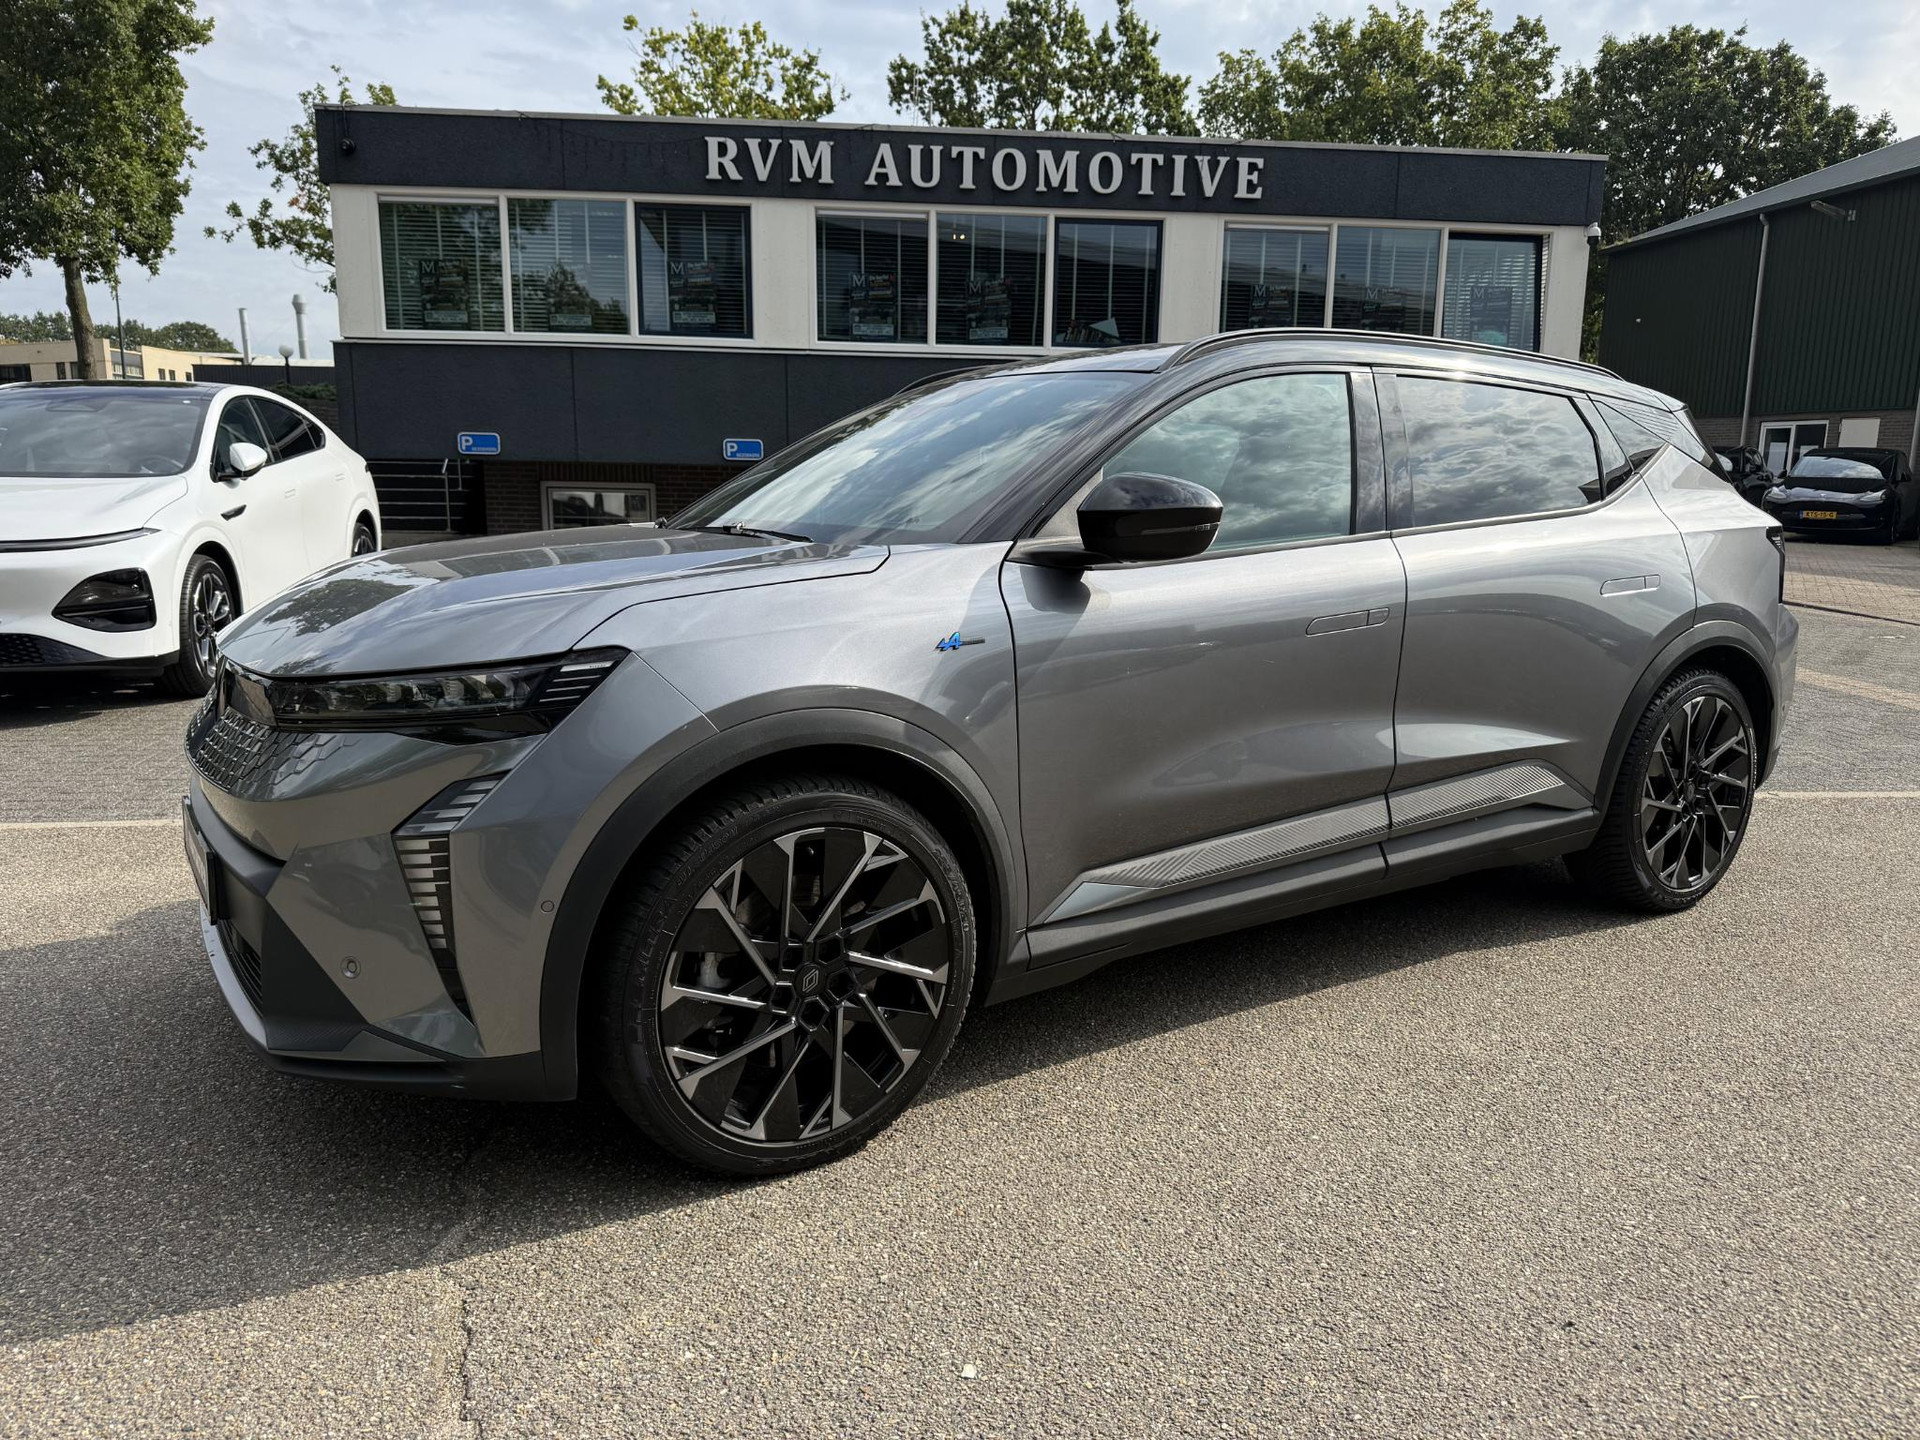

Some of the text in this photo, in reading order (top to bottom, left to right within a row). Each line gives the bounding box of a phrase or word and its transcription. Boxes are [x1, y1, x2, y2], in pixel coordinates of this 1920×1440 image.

[704, 136, 1264, 199] RVM AUTOMOTIVE
[461, 435, 473, 450] P
[727, 442, 738, 456] P
